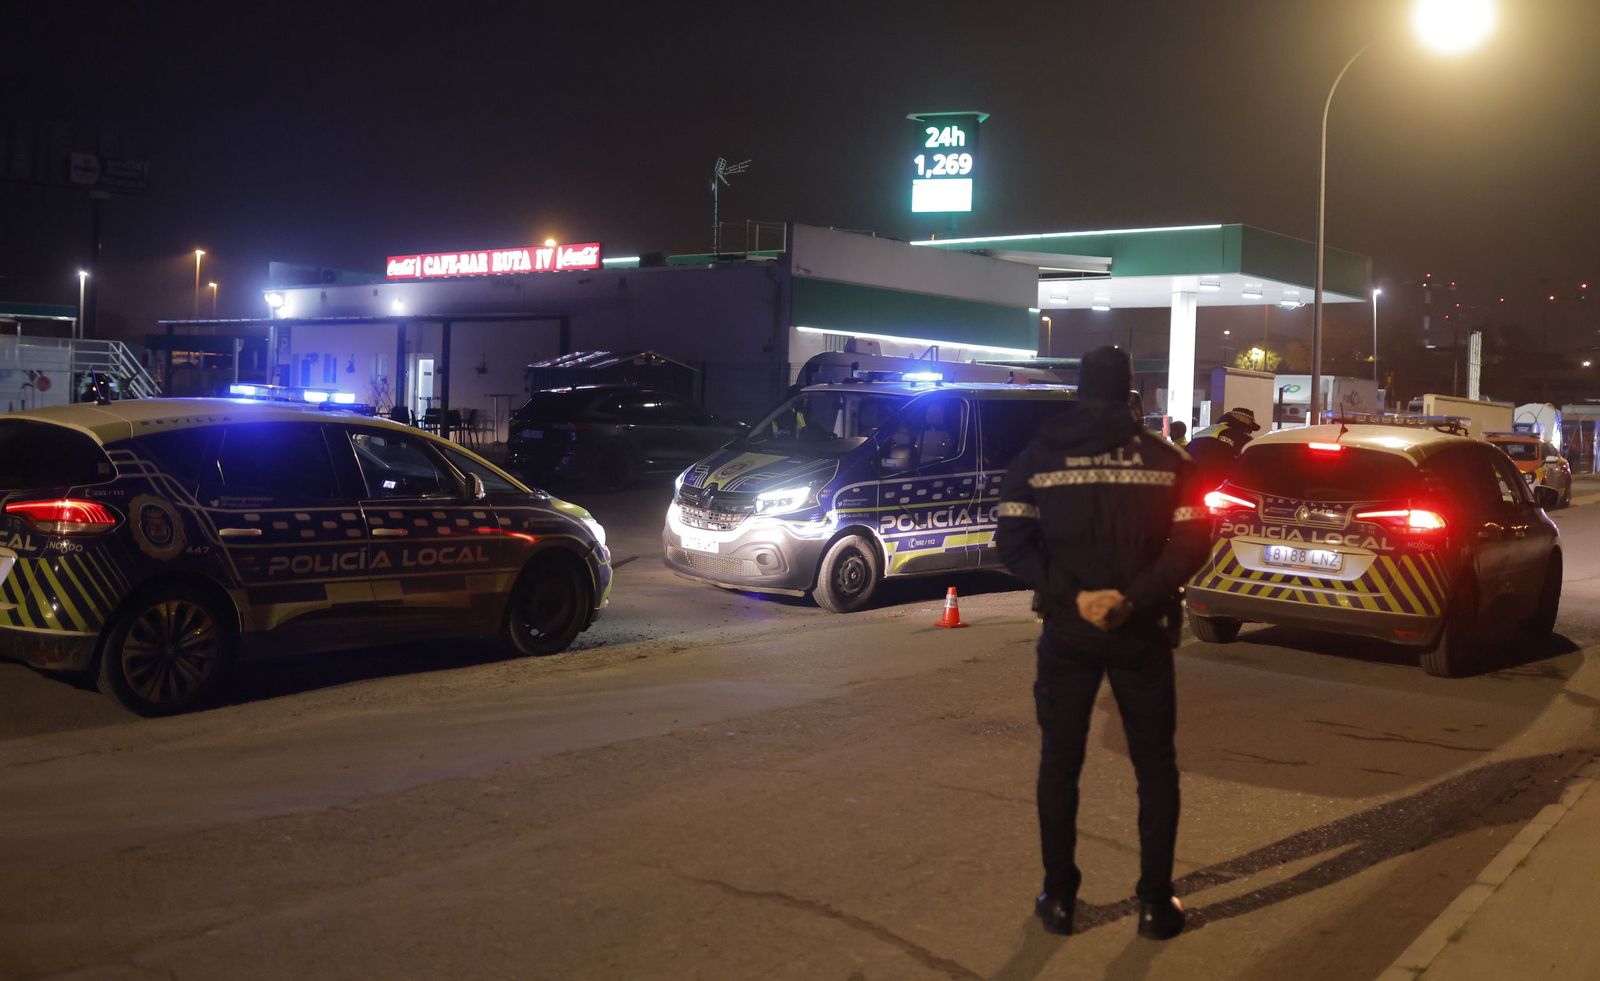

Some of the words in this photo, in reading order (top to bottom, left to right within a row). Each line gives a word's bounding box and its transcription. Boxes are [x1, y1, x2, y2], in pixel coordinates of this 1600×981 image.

[925, 125, 965, 148] 24h
[914, 153, 973, 178] 1,269
[491, 249, 531, 272] RUTA
[535, 248, 554, 270] IV
[880, 506, 973, 534] POLICÍA
[1219, 523, 1305, 541] POLICÍA
[1311, 530, 1395, 551] LOCAL
[268, 547, 392, 575] POLICÍA
[402, 545, 489, 567] LOCAL
[1273, 548, 1307, 563] 8188
[1311, 552, 1338, 567] LNZ
